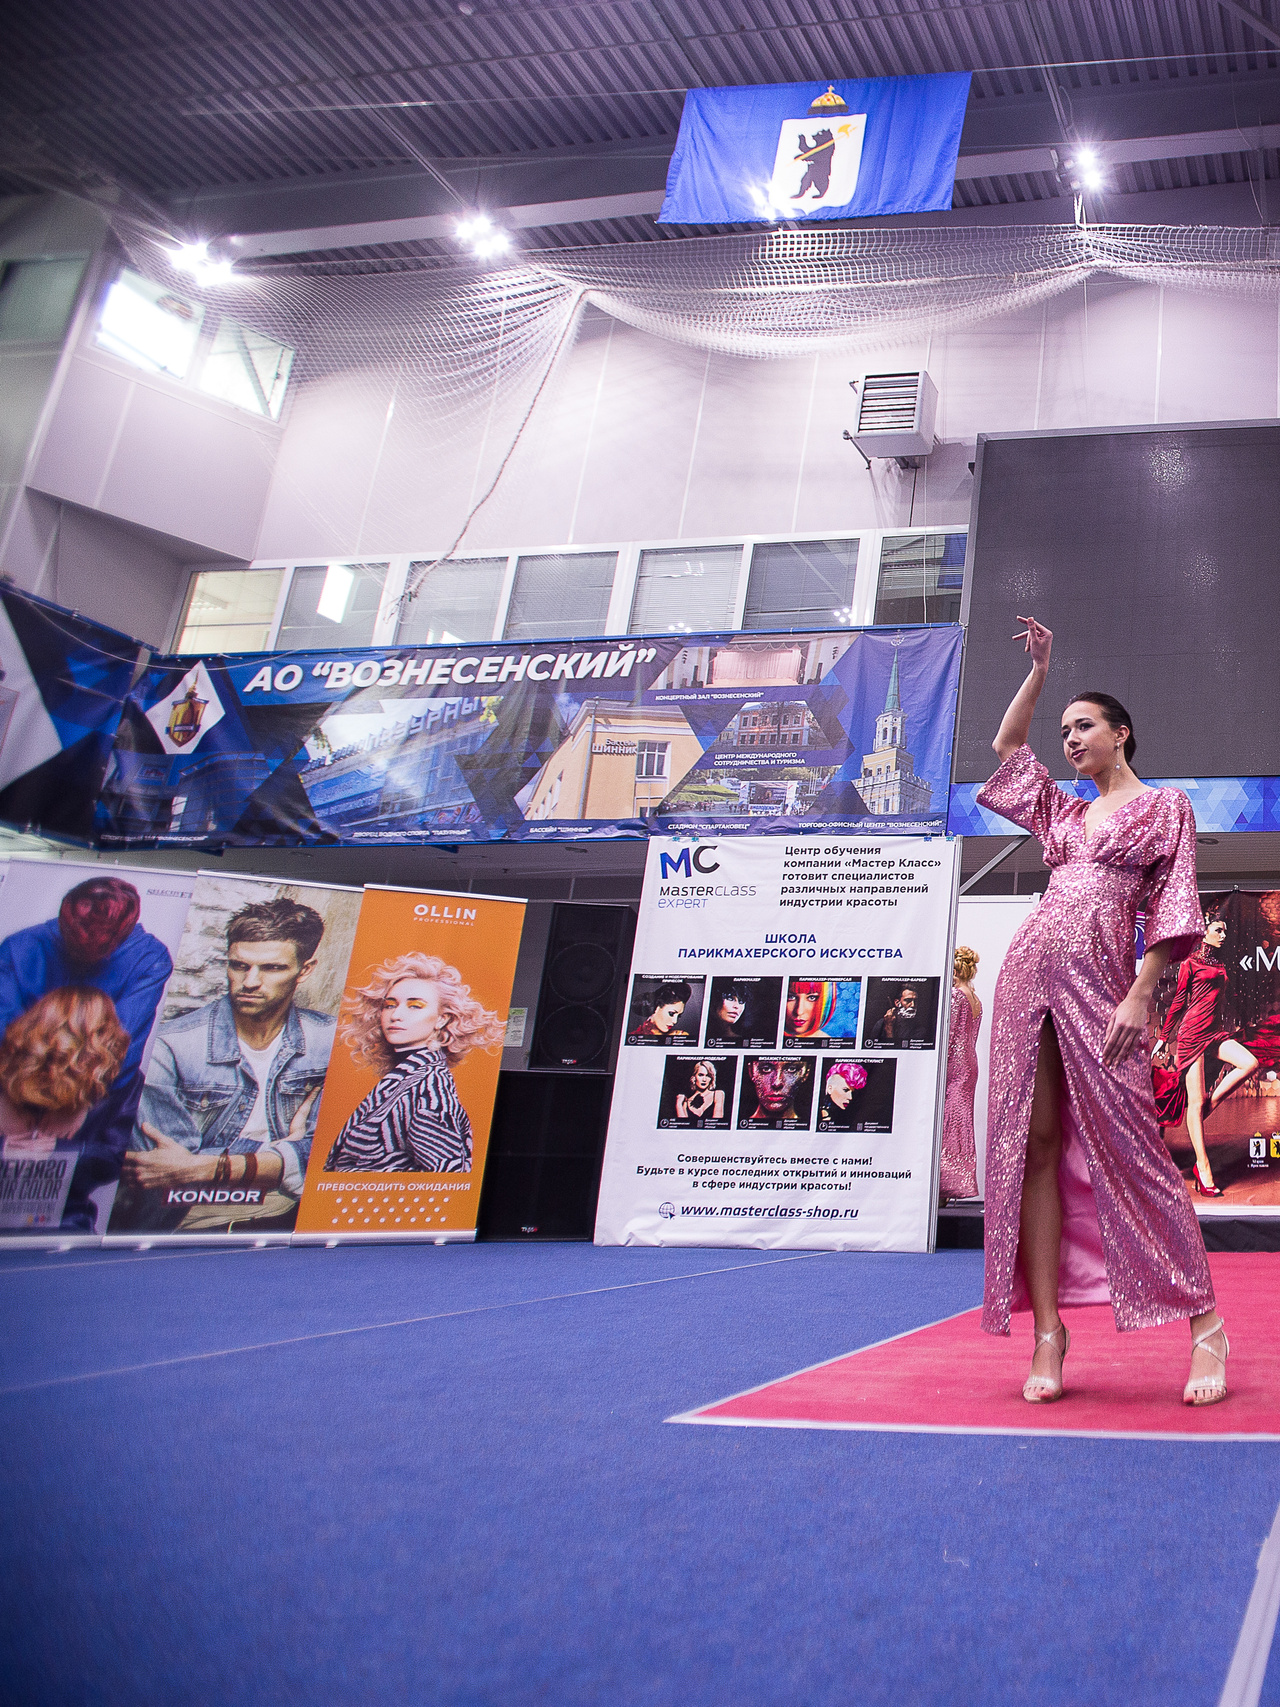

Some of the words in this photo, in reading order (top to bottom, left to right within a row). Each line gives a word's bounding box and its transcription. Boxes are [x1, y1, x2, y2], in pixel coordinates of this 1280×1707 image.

[243, 664, 303, 693] АО
[592, 743, 637, 754] ШИННИК
[785, 846, 820, 856] Центр
[824, 846, 881, 856] обучения
[784, 860, 842, 868] компании
[845, 859, 894, 869] «Мастер
[899, 859, 941, 868] Класс»
[832, 872, 914, 882] специалистов
[780, 886, 846, 896] различных
[850, 883, 928, 894] направлений
[780, 898, 843, 908] индустрии
[846, 898, 898, 908] красоты
[414, 904, 477, 920] OLLIN
[414, 917, 474, 926] PROFESSIONAL
[765, 934, 816, 944] ШКОЛА
[678, 948, 816, 958] ПАРИКМАХЕРСКОГО
[820, 948, 903, 958] ИСКУССТВА
[677, 1154, 787, 1165] Совершенствуйтесь
[790, 1157, 829, 1165] вместе
[841, 1157, 873, 1166] нами!
[637, 1165, 674, 1176] Будьте
[688, 1168, 719, 1177] курсе
[722, 1168, 779, 1177] последних
[783, 1168, 837, 1179] открытий
[850, 1168, 912, 1180] инноваций
[19, 1180, 62, 1199] COLOR
[317, 1182, 405, 1192] ПРЕВОСХОДИТЬ
[408, 1182, 471, 1192] ОЖИДАНИЯ
[702, 1179, 736, 1191] сфере
[739, 1182, 797, 1192] индустрии
[800, 1181, 851, 1192] красоты!
[167, 1190, 261, 1203] KONDOR
[680, 1205, 858, 1220] www.masterclass-shop.ru
